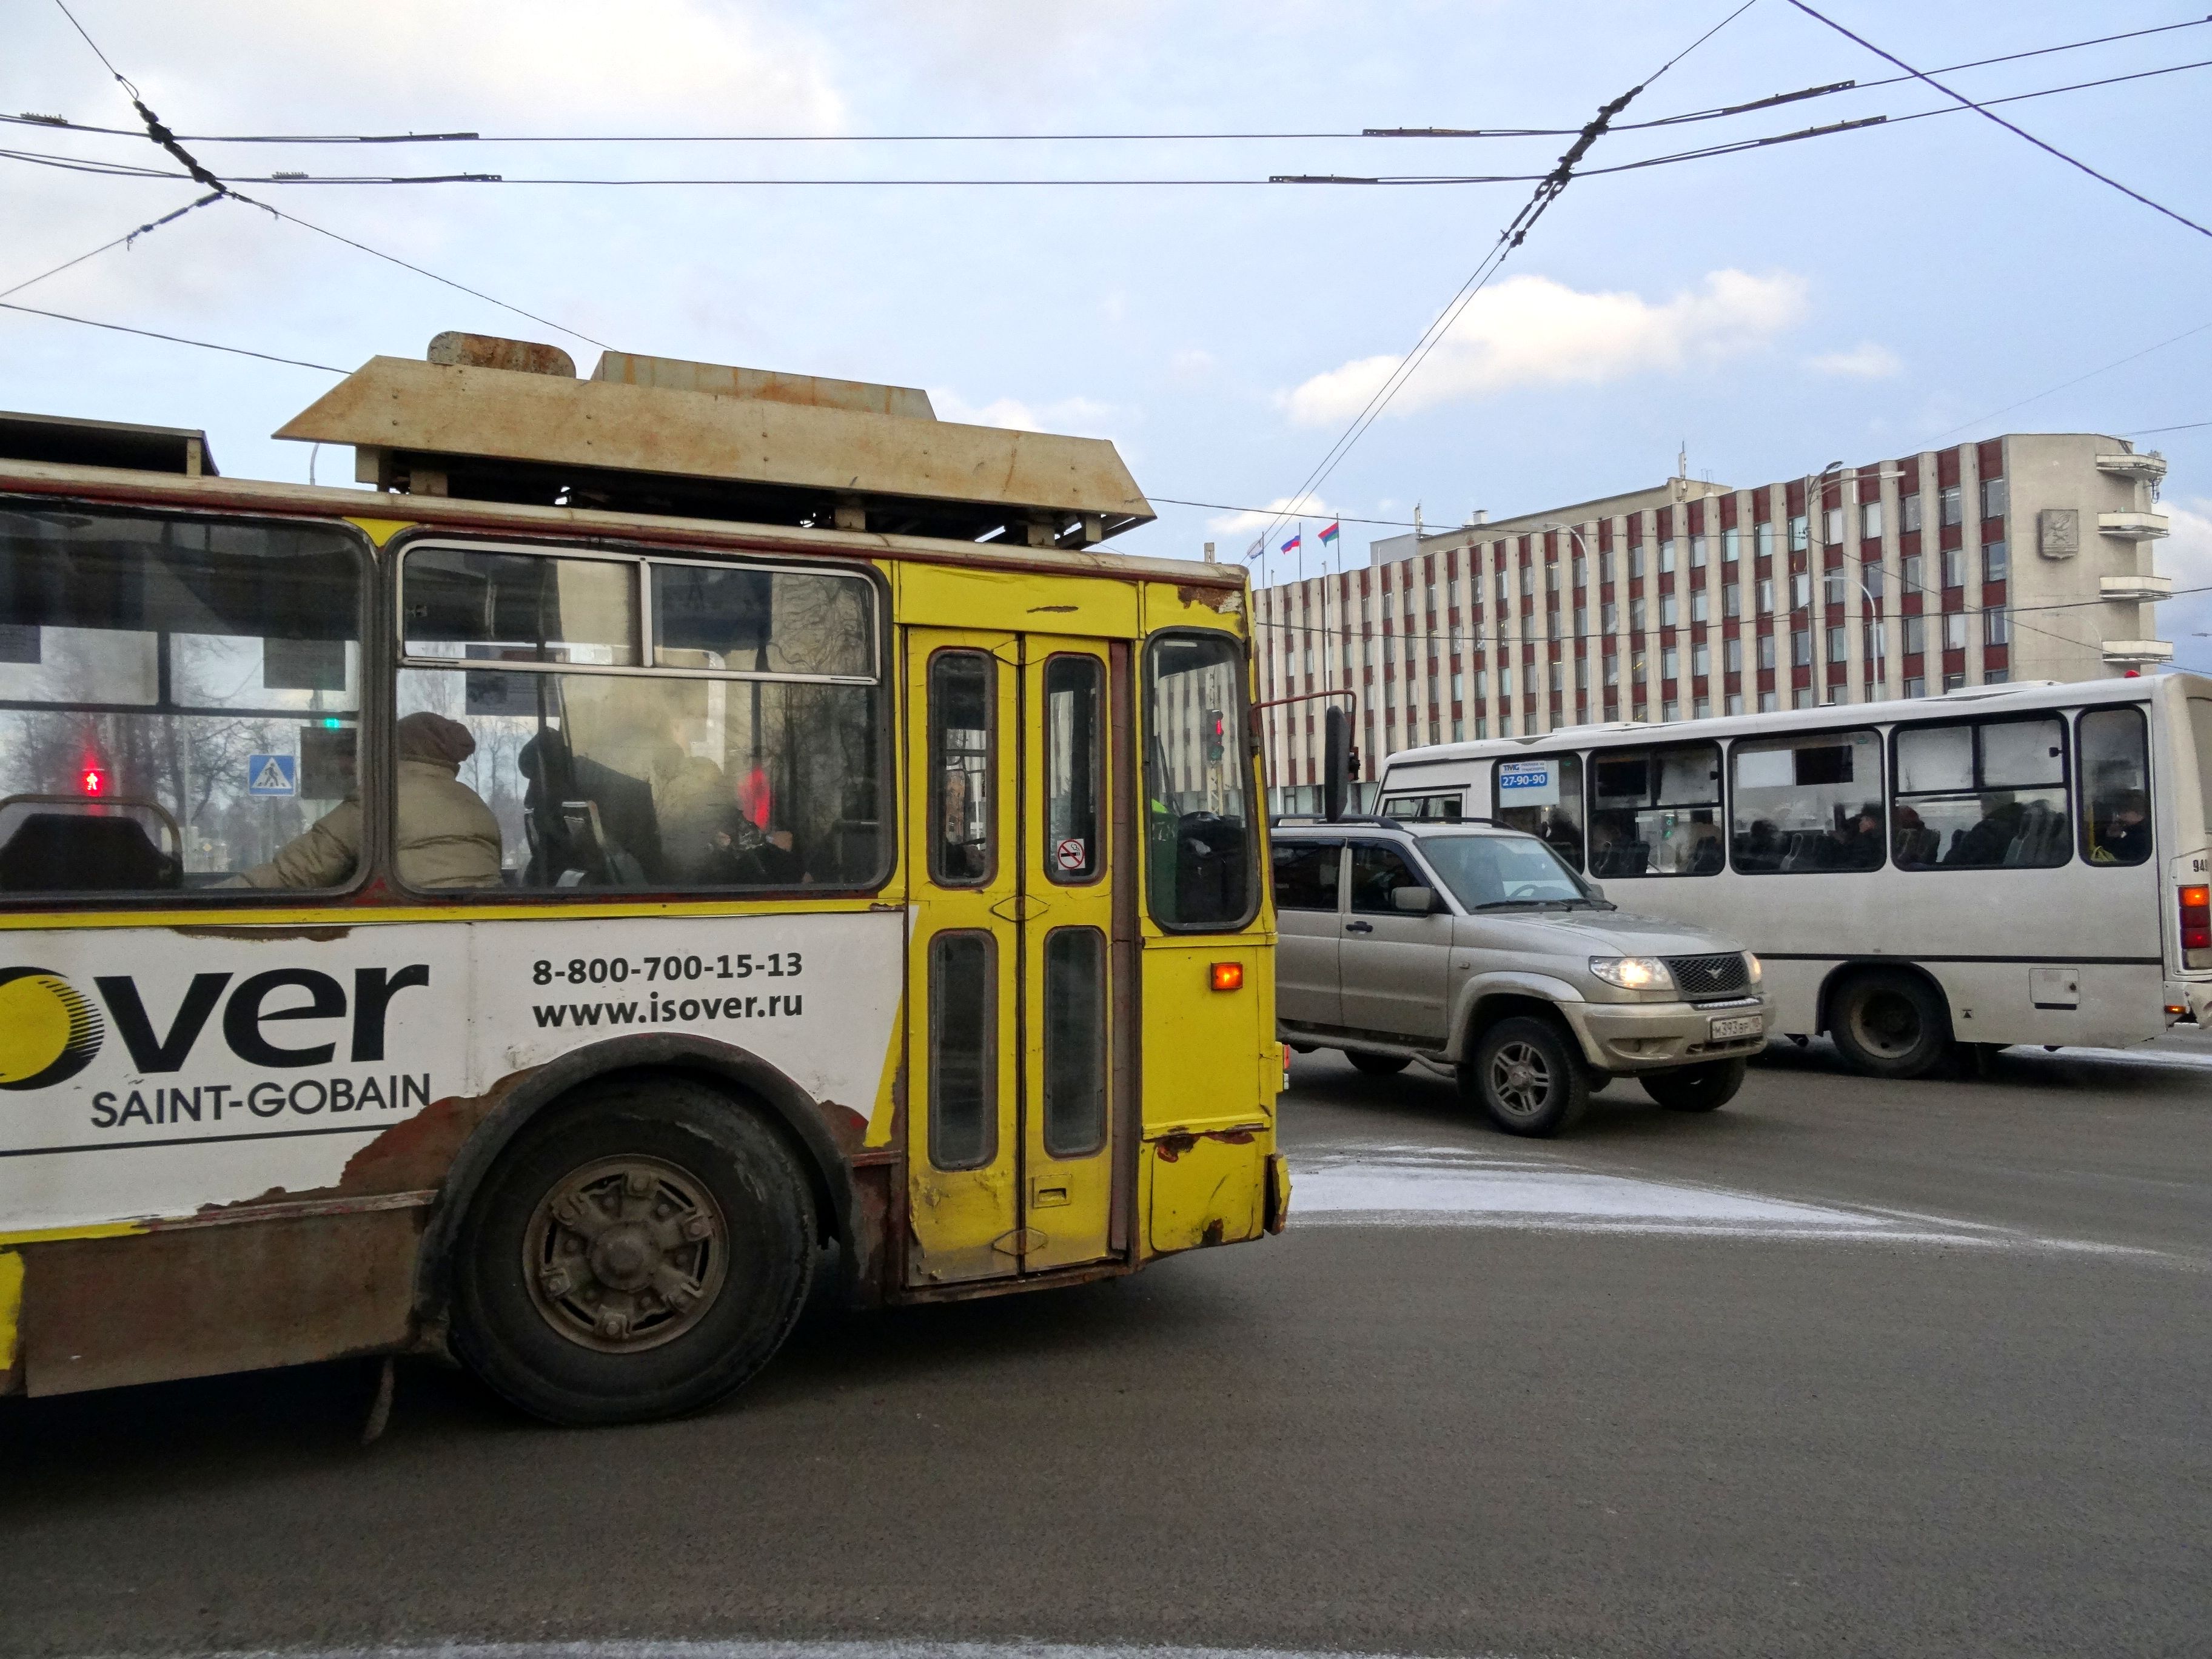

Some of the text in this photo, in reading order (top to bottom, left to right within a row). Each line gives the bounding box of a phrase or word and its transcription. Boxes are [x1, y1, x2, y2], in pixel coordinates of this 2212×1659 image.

[1503, 774, 1546, 786] 27-90-90
[533, 953, 803, 985] 8-800-700-15-13
[533, 993, 803, 1027] www.isover.ru
[92, 1073, 430, 1128] SAINT-GOBAIN
